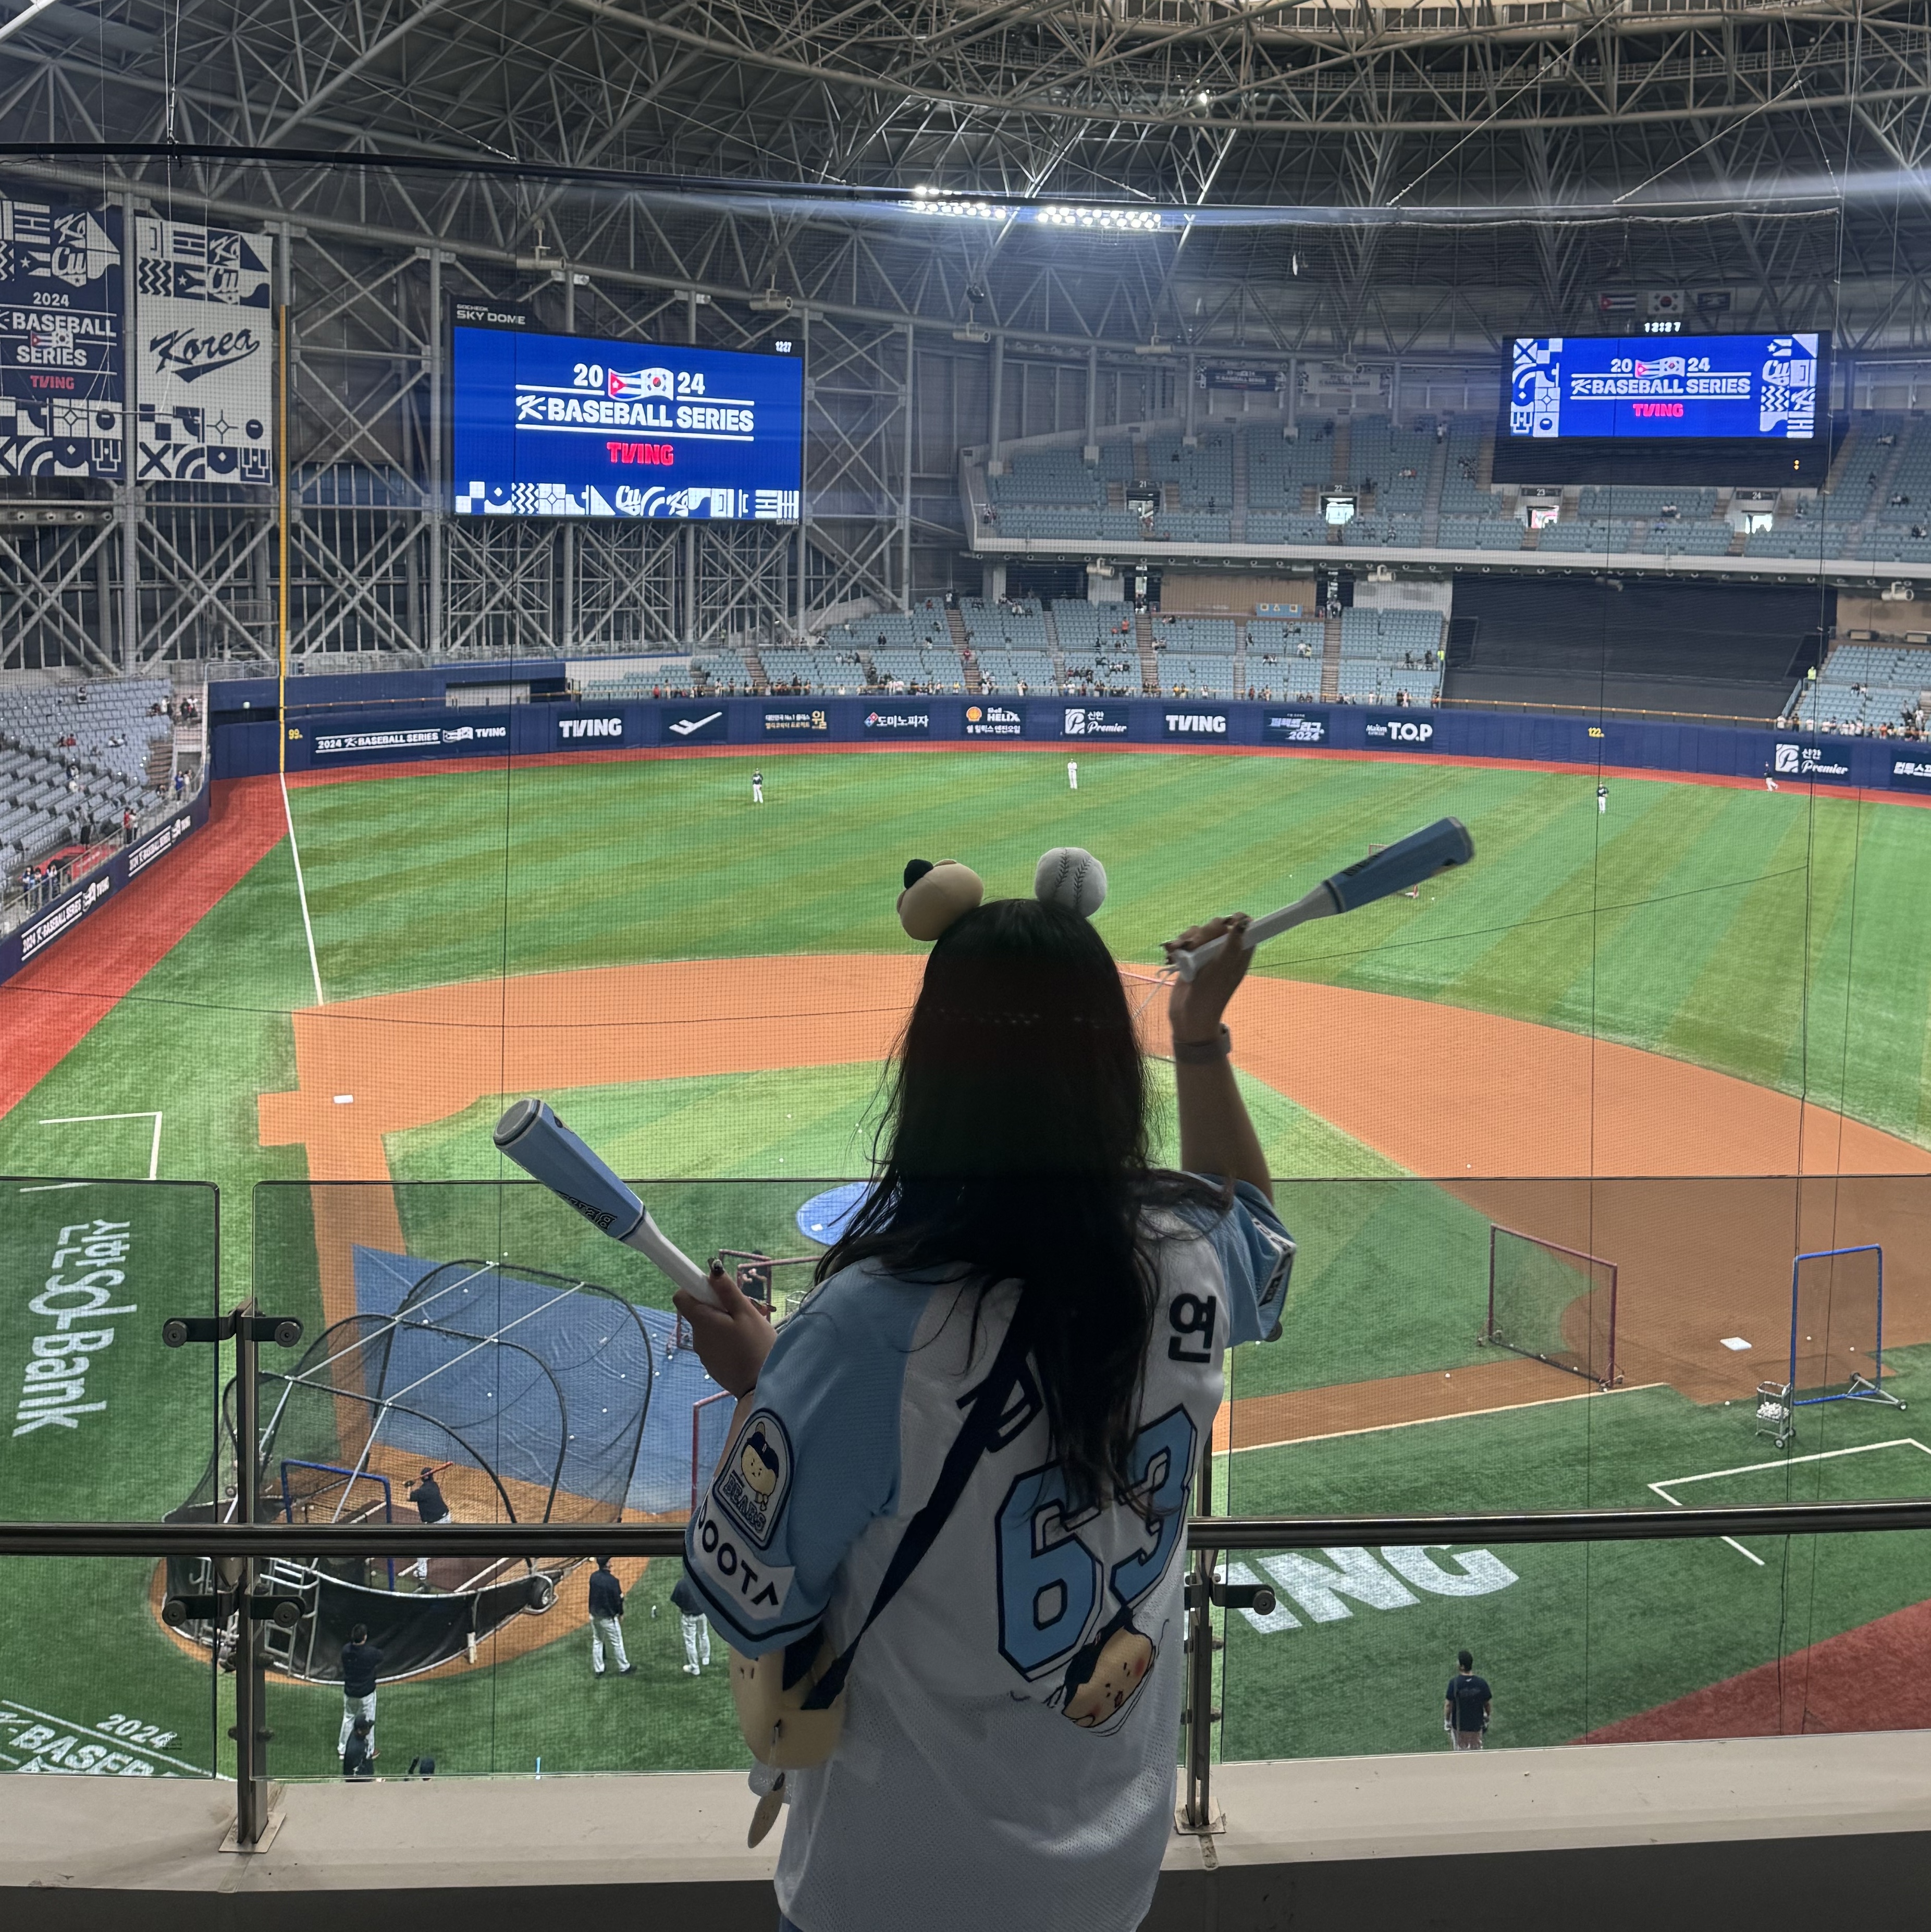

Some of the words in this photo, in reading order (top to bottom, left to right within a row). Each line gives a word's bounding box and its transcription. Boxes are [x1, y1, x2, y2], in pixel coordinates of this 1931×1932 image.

[33, 291, 70, 307] 2024
[457, 310, 485, 321] SKY
[488, 313, 525, 325] DOME
[1644, 322, 1681, 333] 12:27
[16, 345, 87, 366] SERIES
[150, 328, 260, 376] Korea
[1610, 358, 1632, 373] 20
[1688, 358, 1711, 373] 24
[30, 375, 75, 390] TVING
[574, 363, 604, 387] 20
[678, 372, 705, 395] 24
[1571, 378, 1683, 395] K-BASEBALL
[1686, 378, 1751, 394] SERIES
[515, 395, 673, 427] K-BASEBALL
[676, 406, 754, 432] SERIES
[1632, 403, 1684, 418] TVING
[607, 442, 674, 466] TVING
[811, 710, 827, 729] 윌
[878, 715, 929, 728] 도미노피자
[987, 712, 1020, 722] HELIX
[1087, 720, 1127, 733] Premier
[1166, 714, 1226, 733] TVING
[559, 718, 622, 738] TVING
[1286, 731, 1320, 741] 2024
[1366, 724, 1387, 732] Maxim
[1388, 722, 1433, 741] T.O.P
[318, 739, 342, 749] 2024
[345, 735, 405, 748] K-BASEBALL
[407, 732, 438, 742] SERIES
[475, 727, 506, 738] TVING
[1801, 760, 1849, 775] Premier
[52, 1219, 130, 1268] 신한
[12, 1327, 115, 1437] Bank
[723, 1474, 767, 1534] BEARS
[96, 1714, 178, 1748] 2024
